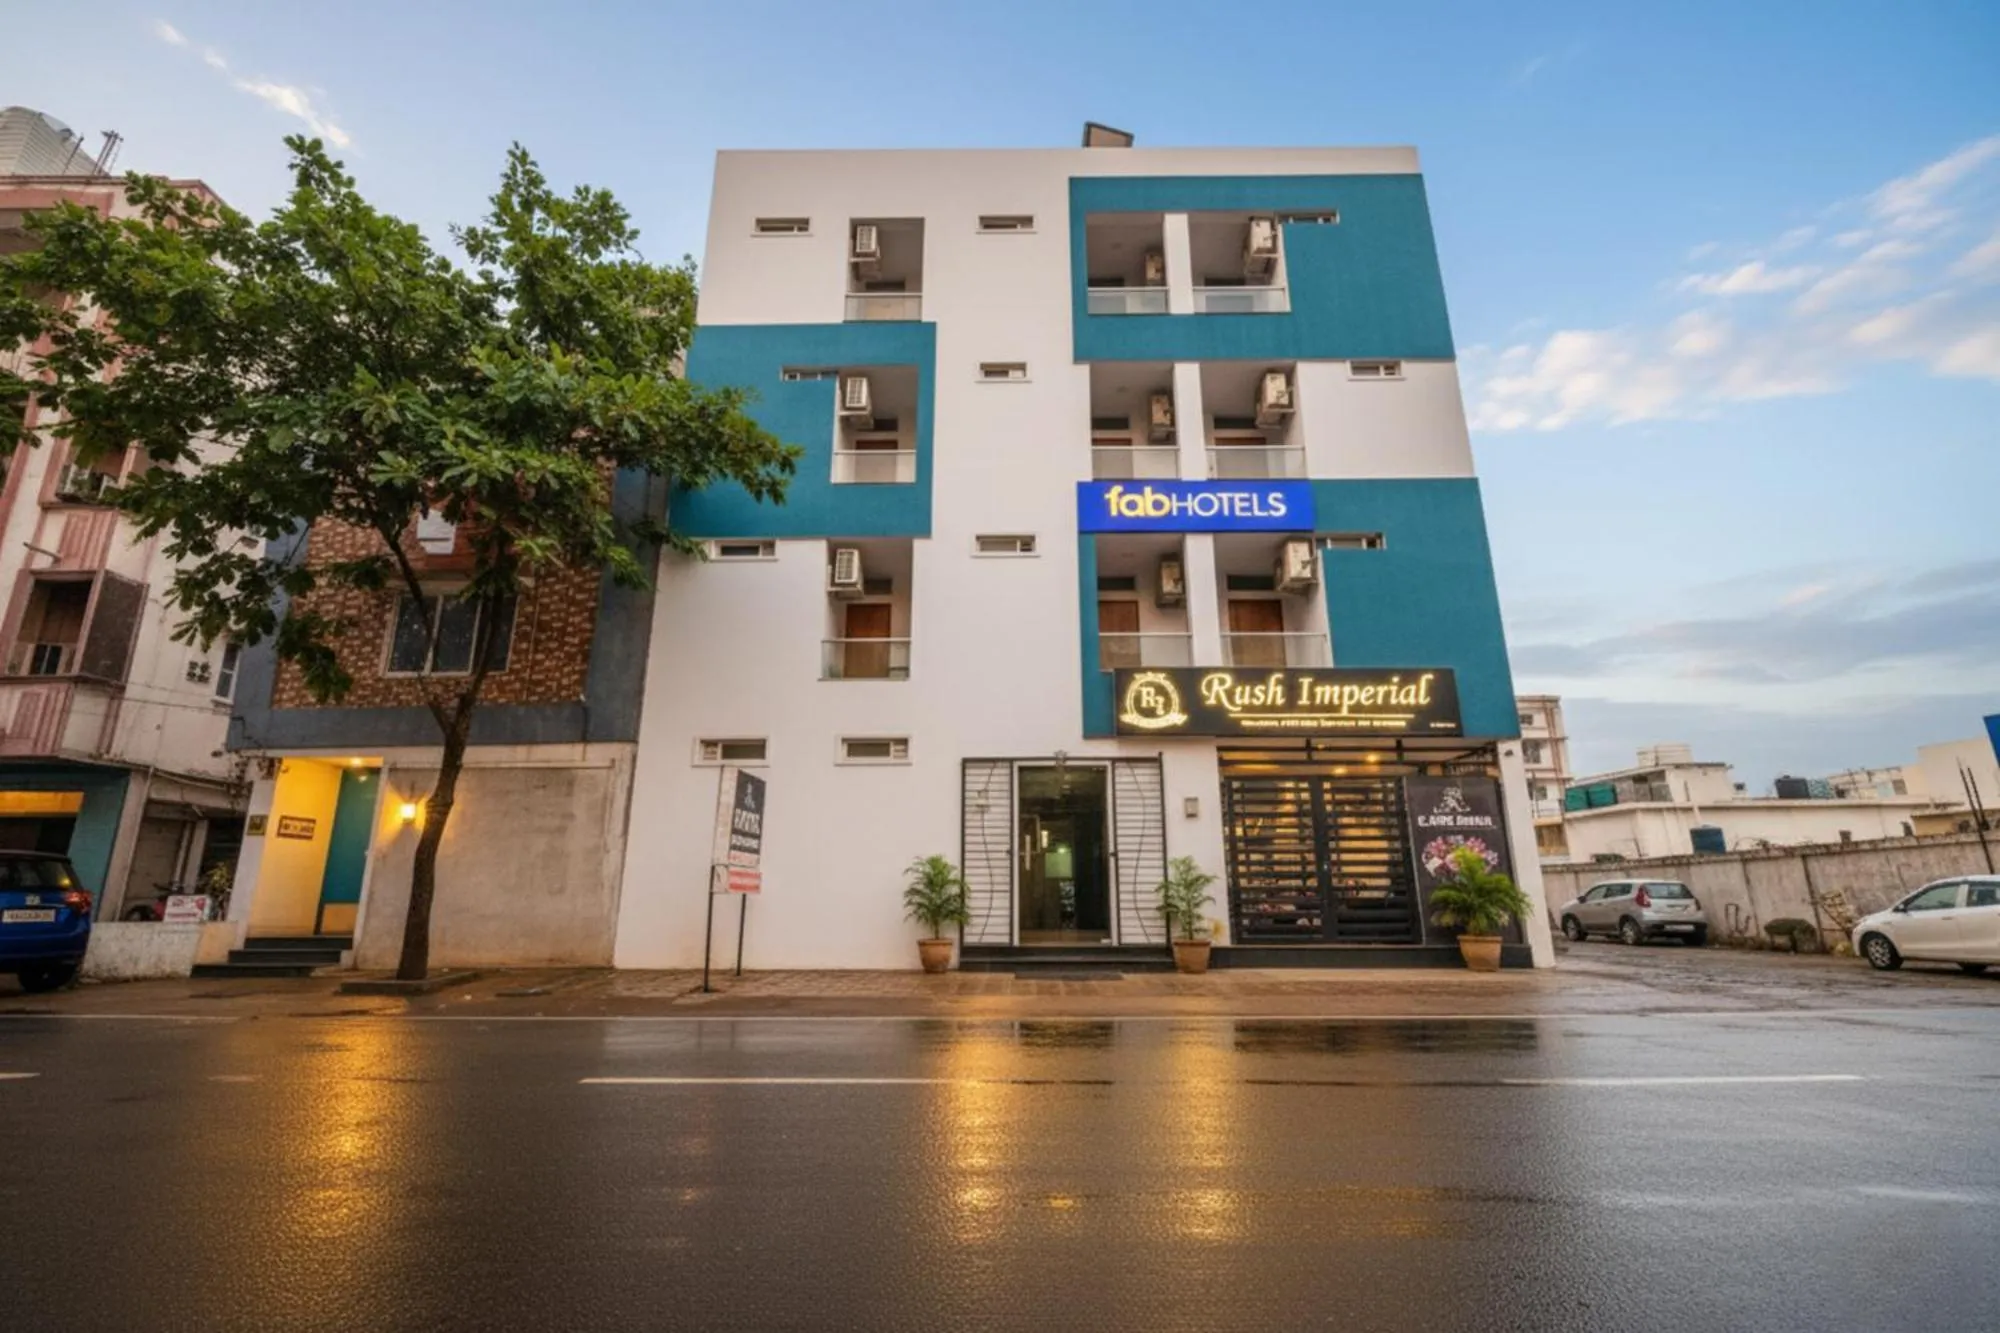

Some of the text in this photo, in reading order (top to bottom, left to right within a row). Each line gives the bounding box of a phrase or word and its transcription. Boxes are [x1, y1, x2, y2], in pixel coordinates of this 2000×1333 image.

[1104, 485, 1287, 517] fabHOTELS
[1201, 673, 1435, 715] Rush Imperial
